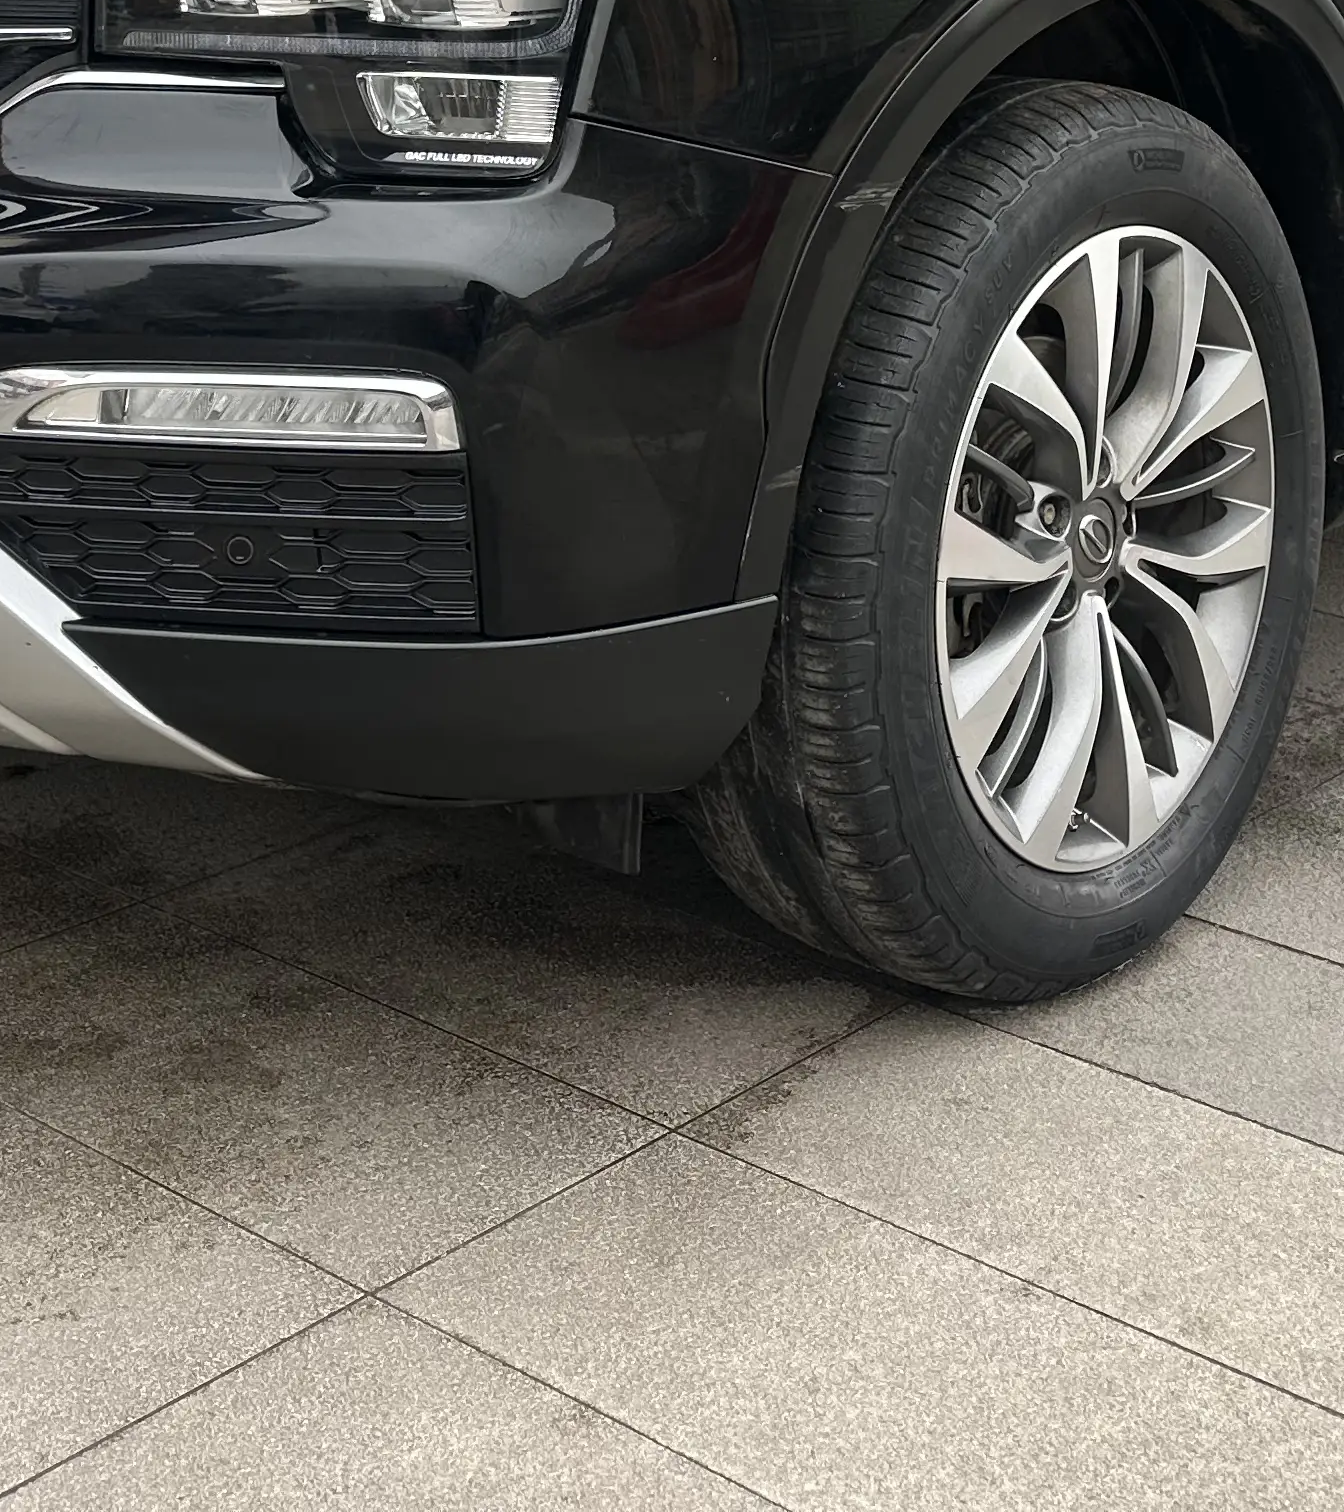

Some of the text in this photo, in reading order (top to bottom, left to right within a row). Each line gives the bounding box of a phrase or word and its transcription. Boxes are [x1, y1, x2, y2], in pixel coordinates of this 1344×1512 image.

[427, 152, 451, 162] FULL
[451, 153, 471, 163] LED
[472, 154, 538, 165] TECHNOLOGY
